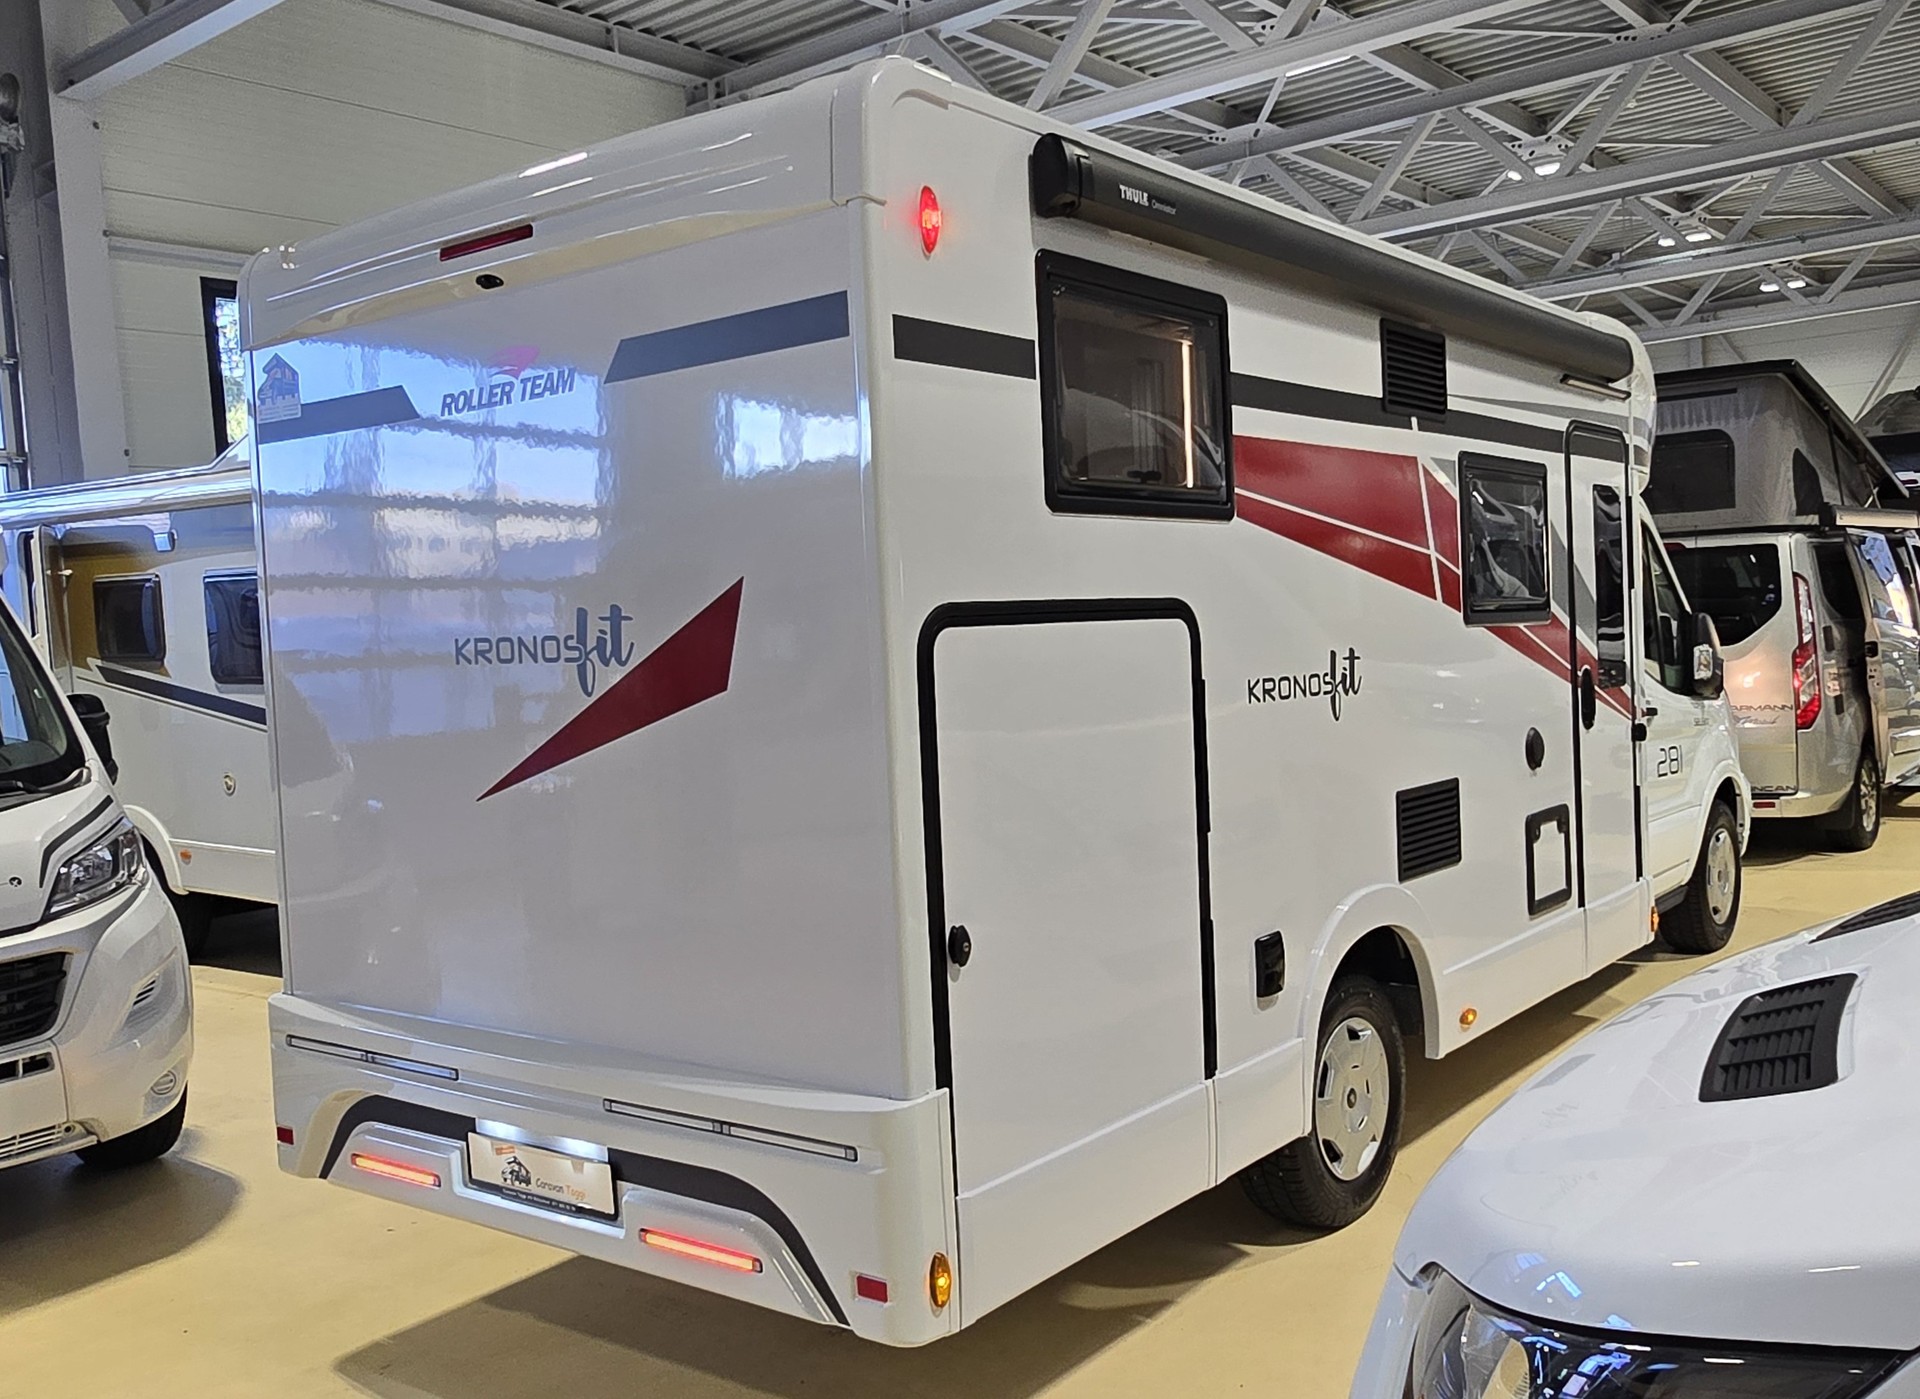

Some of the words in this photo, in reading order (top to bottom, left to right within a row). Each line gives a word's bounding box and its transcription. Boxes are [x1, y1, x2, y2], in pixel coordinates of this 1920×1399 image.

[1119, 185, 1149, 206] THULE
[440, 380, 516, 417] ROLLER
[519, 367, 577, 402] TEAM
[1657, 744, 1683, 778] 281
[535, 1177, 565, 1194] Caravan
